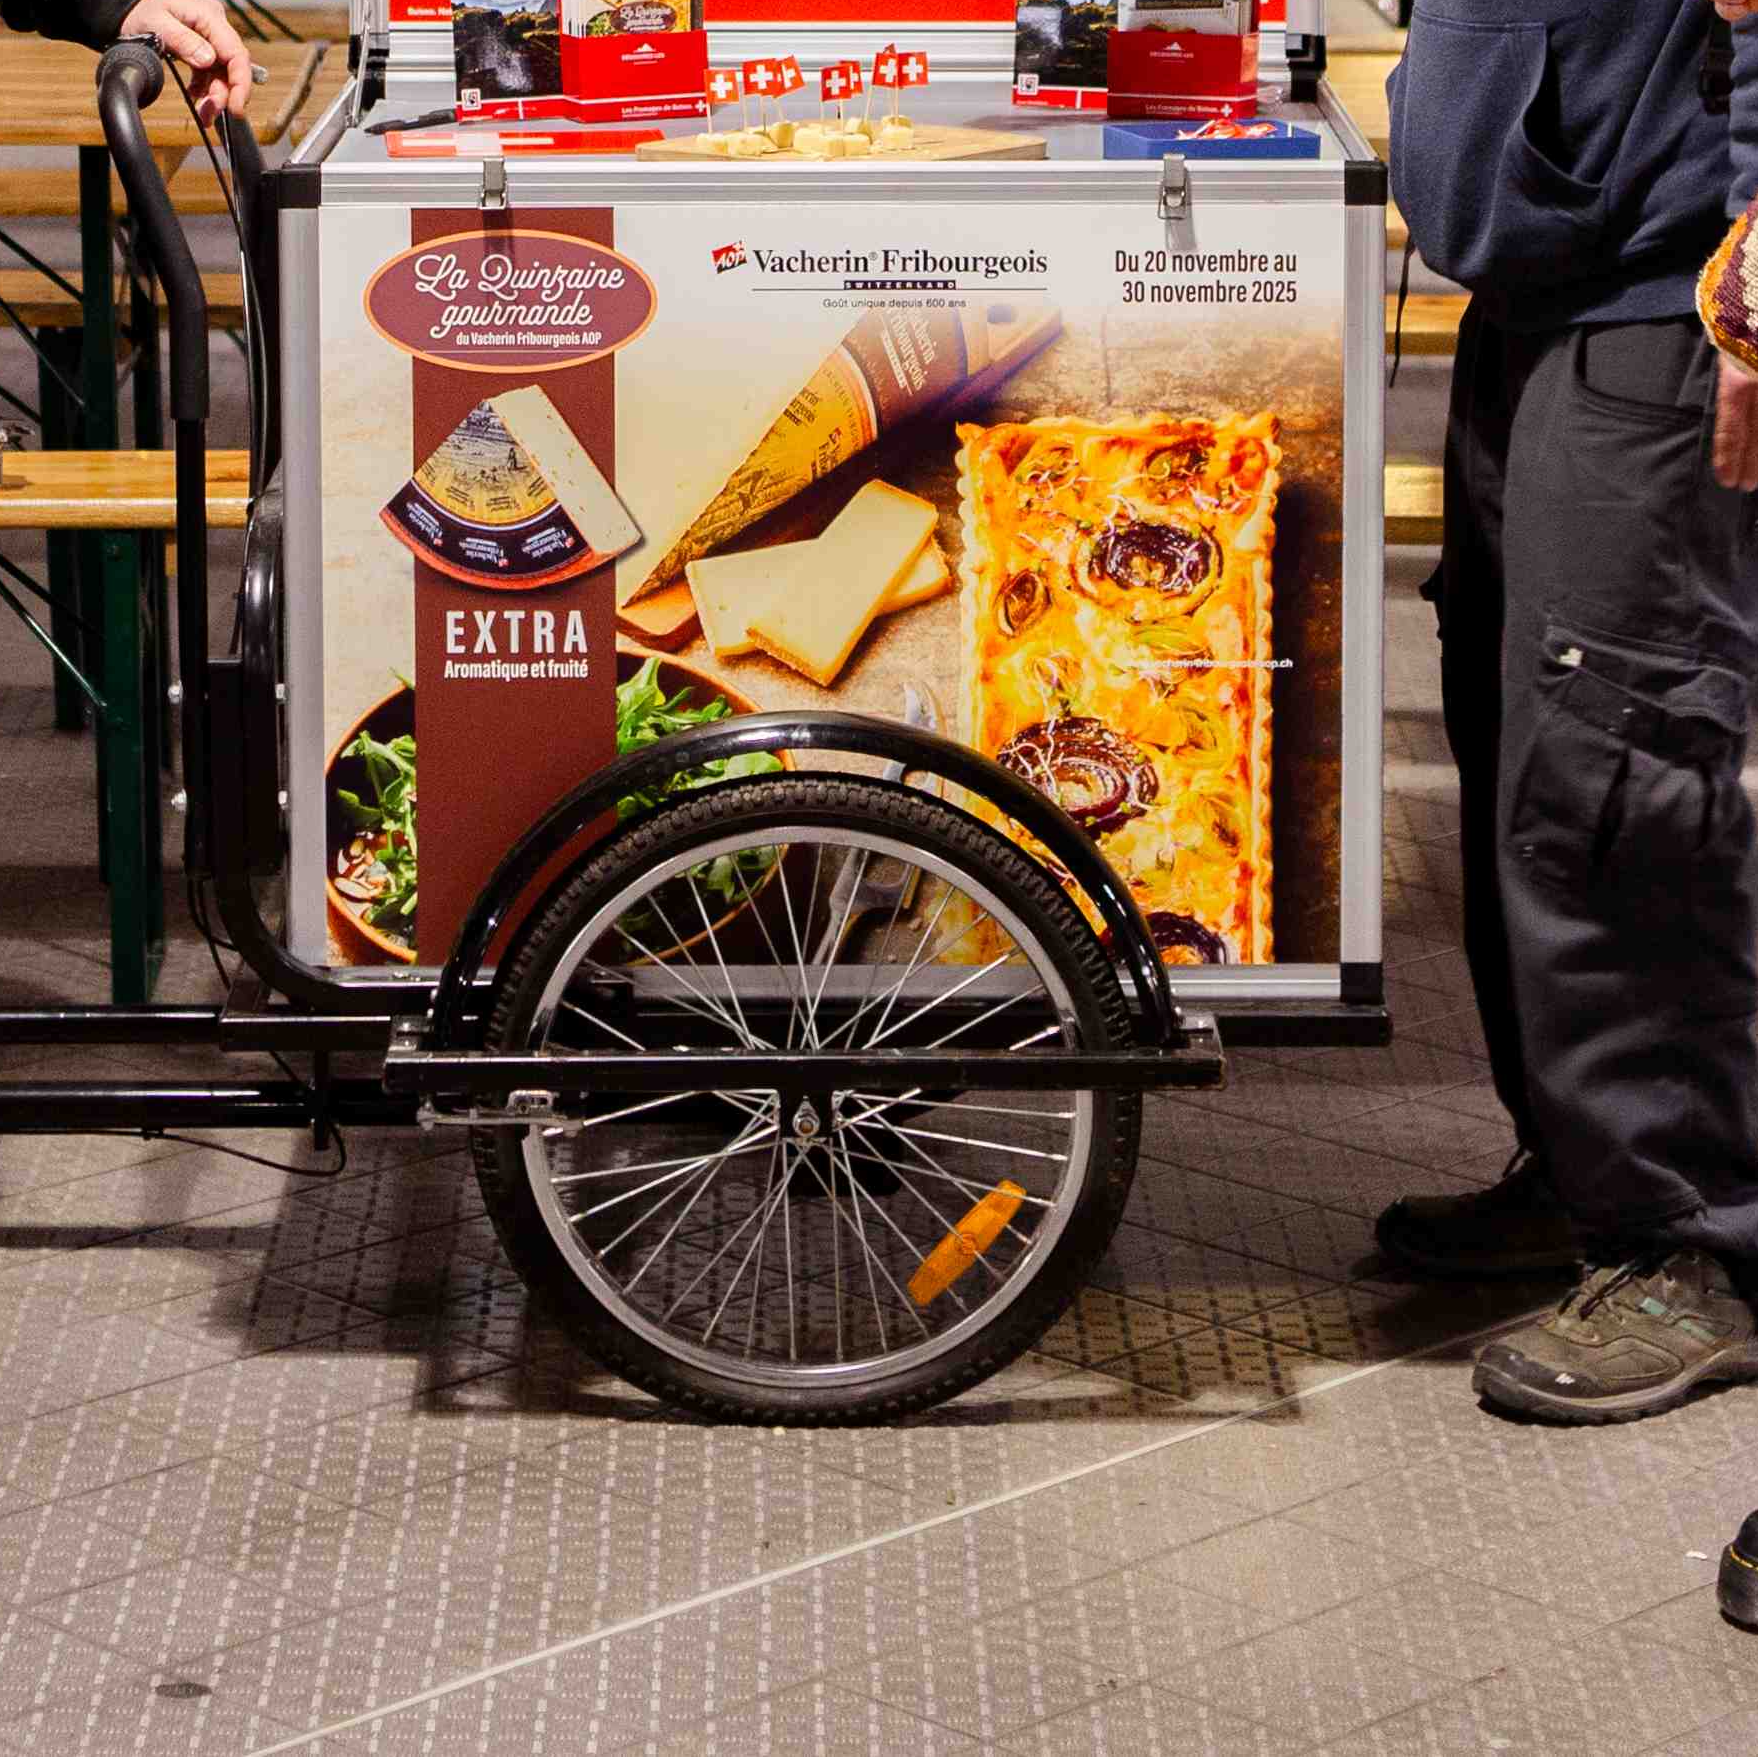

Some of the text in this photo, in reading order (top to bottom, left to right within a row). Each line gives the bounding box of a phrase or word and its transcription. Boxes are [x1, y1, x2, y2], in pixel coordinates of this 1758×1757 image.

[882, 249, 1048, 280] Fribourgeois
[1115, 249, 1297, 273] Du 20 novembre au
[415, 253, 625, 302] La Quinzaine
[844, 280, 956, 290] SWITZERLAND
[1122, 279, 1297, 303] 30 novembre 2025
[430, 290, 593, 339] gourmande
[823, 297, 967, 311] Goût unique depuis 600 ans
[456, 331, 603, 348] du Vacherin Fribourgeois AOP
[445, 609, 589, 654] EXTRA
[444, 659, 589, 683] Aromatique et fruité
